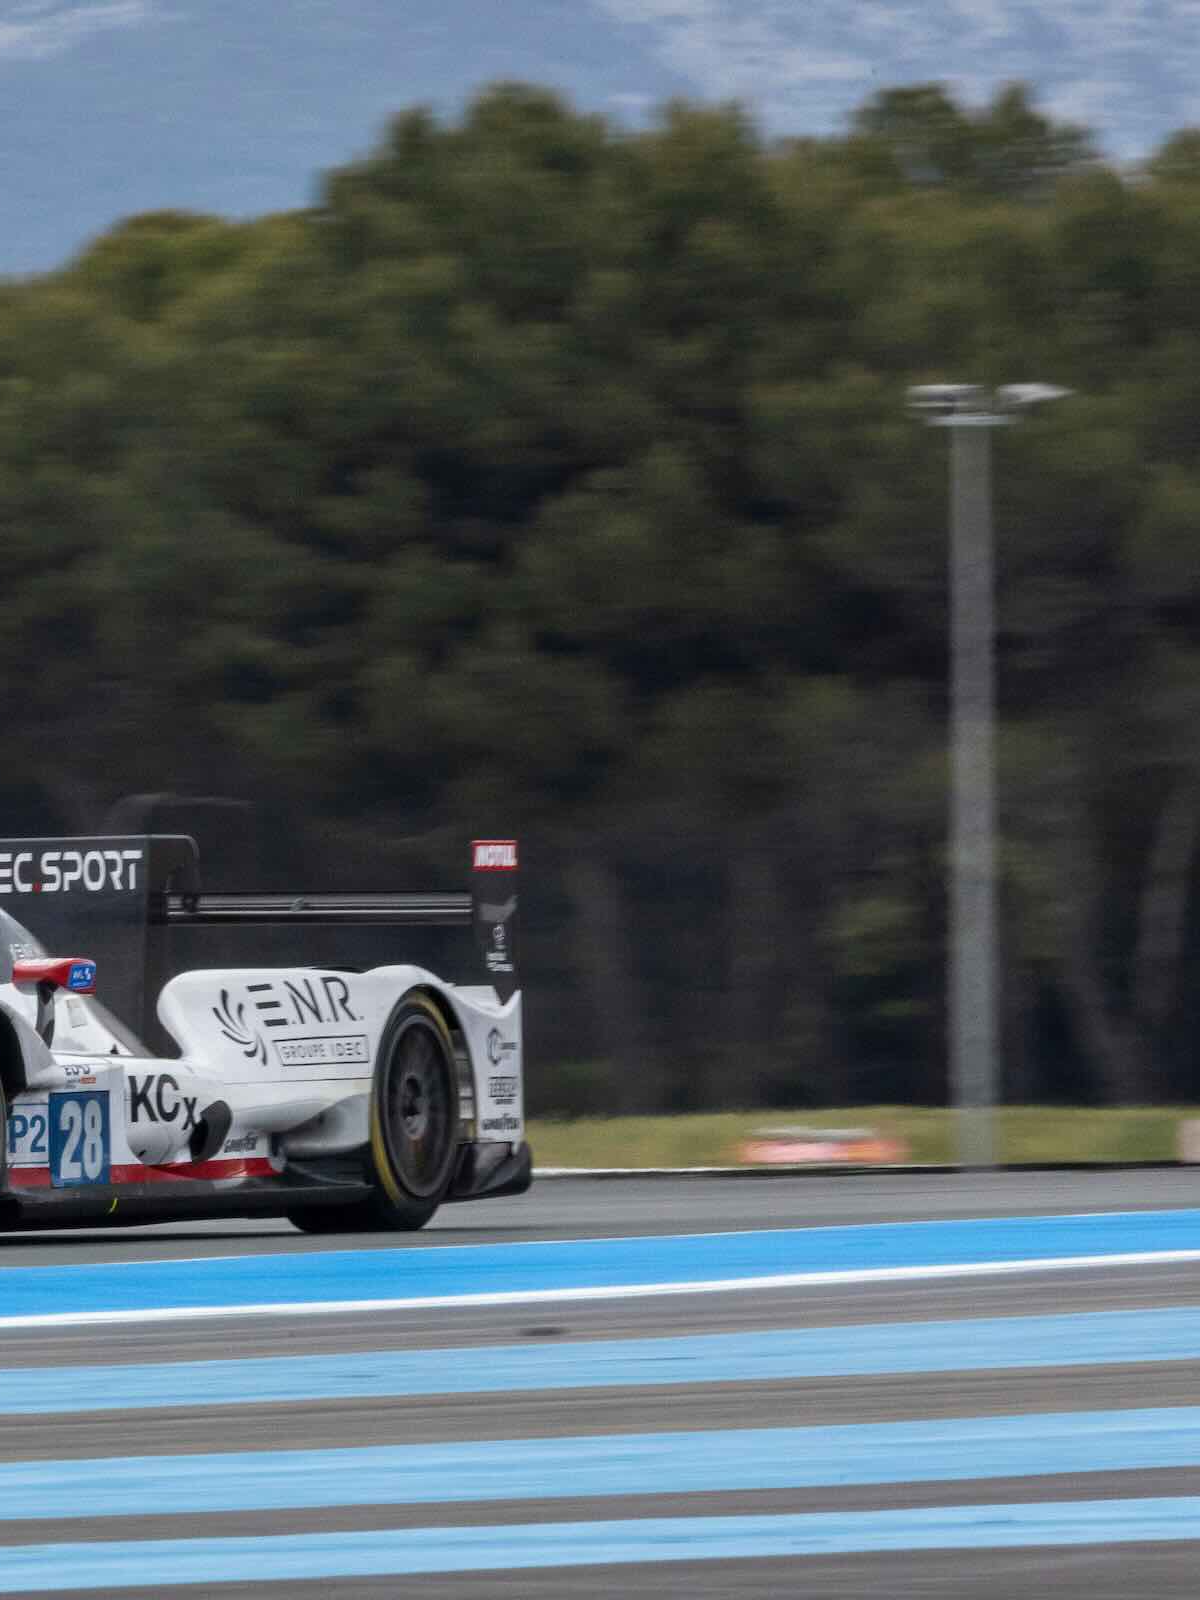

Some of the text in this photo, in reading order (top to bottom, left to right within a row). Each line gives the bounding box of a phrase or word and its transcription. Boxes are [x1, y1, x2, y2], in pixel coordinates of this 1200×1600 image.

[281, 1042, 362, 1058] GROUPE IDEC
[8, 1115, 46, 1153] P2
[61, 1100, 103, 1180] 28
